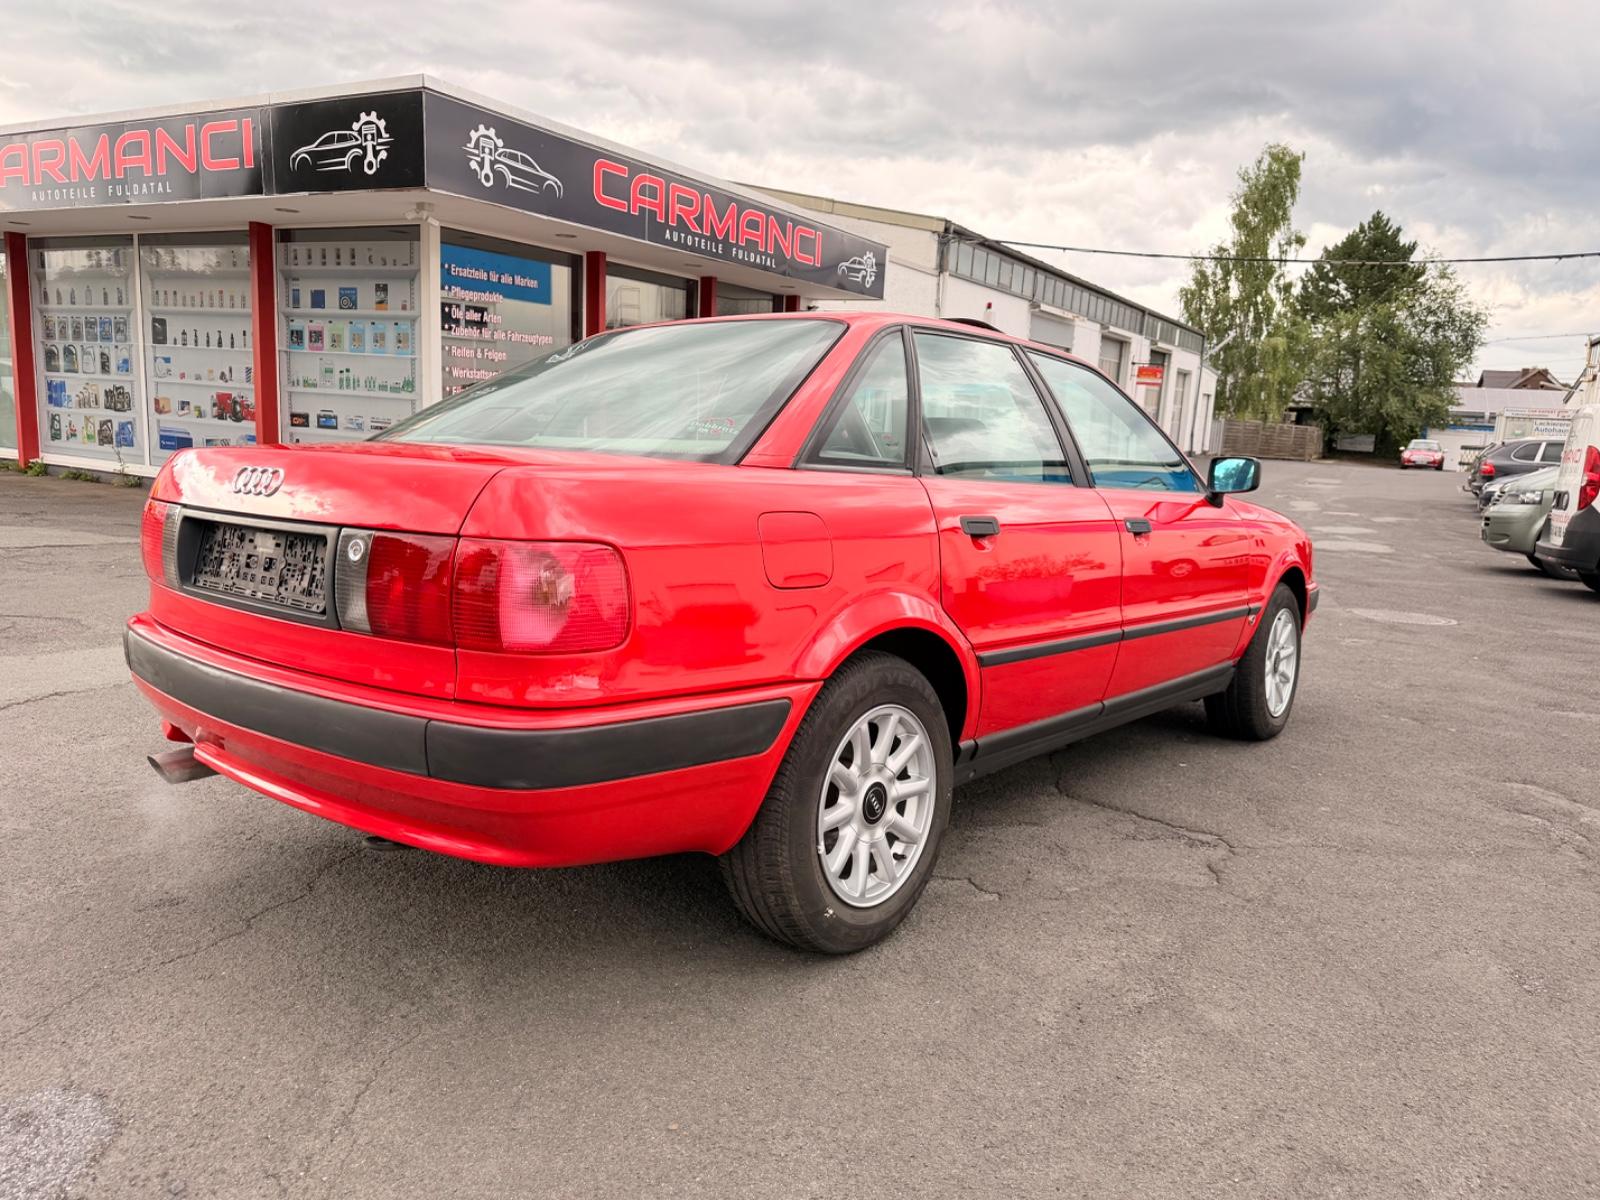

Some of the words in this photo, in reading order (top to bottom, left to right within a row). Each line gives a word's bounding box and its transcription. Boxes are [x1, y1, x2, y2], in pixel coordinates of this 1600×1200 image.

[32, 186, 96, 201] AUTOTEILE
[108, 181, 173, 197] FULDATAL
[593, 158, 823, 268] CARMANCI
[665, 228, 724, 254] AUTOTEILE
[732, 247, 777, 268] FULDATAL
[451, 264, 488, 281] Ersatzteile
[489, 269, 499, 282] für
[501, 273, 513, 285] alle
[514, 274, 539, 289] Marken
[451, 285, 504, 303] Pflegeprodukte
[451, 304, 463, 319] Öle
[465, 309, 481, 322] aller
[482, 310, 502, 324] Arten
[451, 324, 480, 337] Zubehör
[482, 327, 491, 338] für
[493, 329, 506, 340] alle
[507, 330, 553, 346] Fahrzeugtypen
[451, 345, 475, 358] Reifen
[476, 348, 482, 358] &
[484, 348, 507, 362] Felgen
